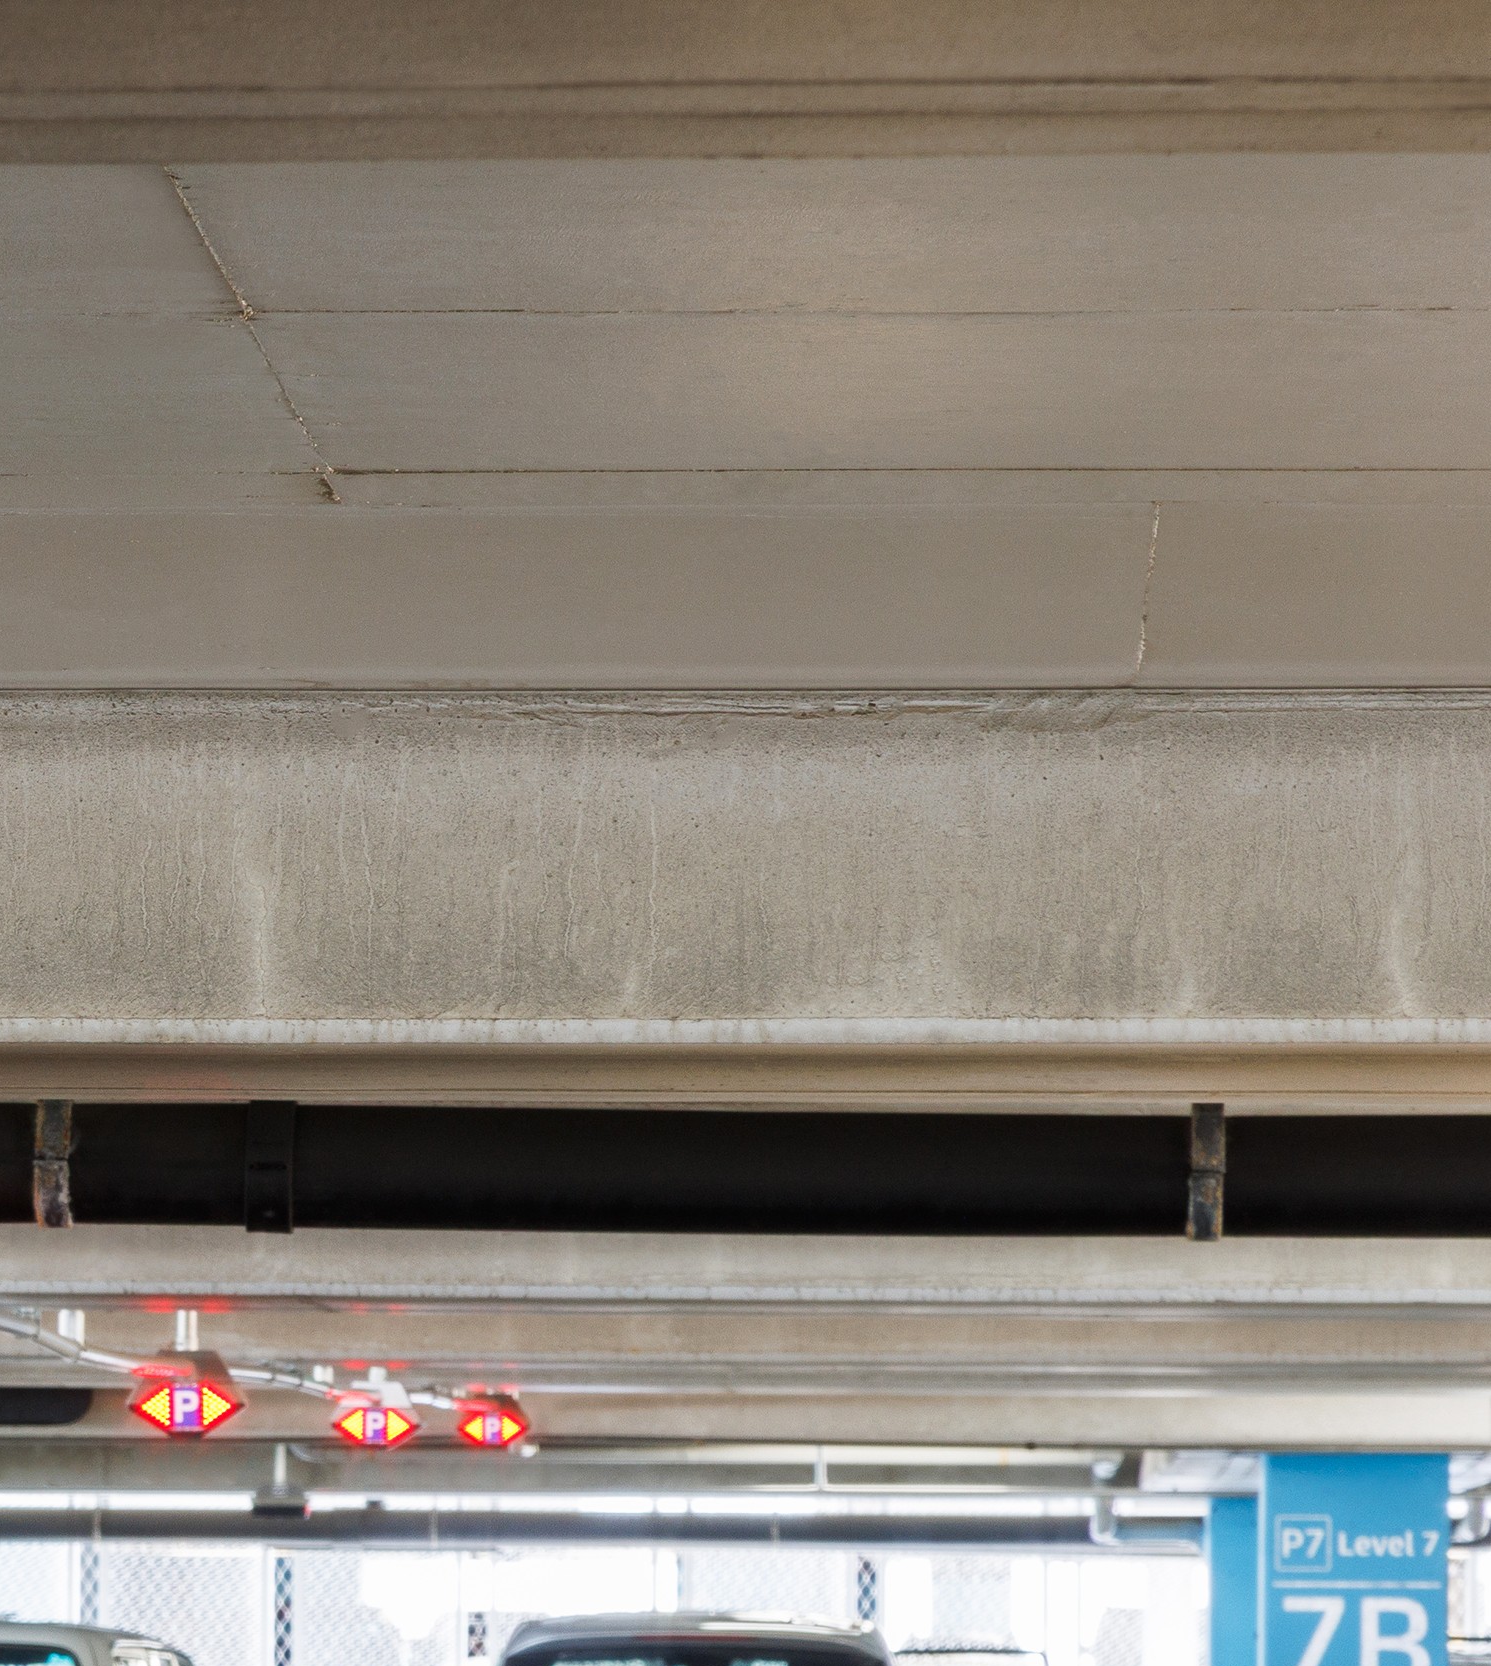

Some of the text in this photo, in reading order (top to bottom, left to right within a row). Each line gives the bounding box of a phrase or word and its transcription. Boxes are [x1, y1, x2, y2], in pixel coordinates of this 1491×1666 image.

[172, 1390, 200, 1424] P
[365, 1410, 386, 1438] P
[484, 1416, 501, 1441] P
[1281, 1527, 1440, 1559] P7 Level 7
